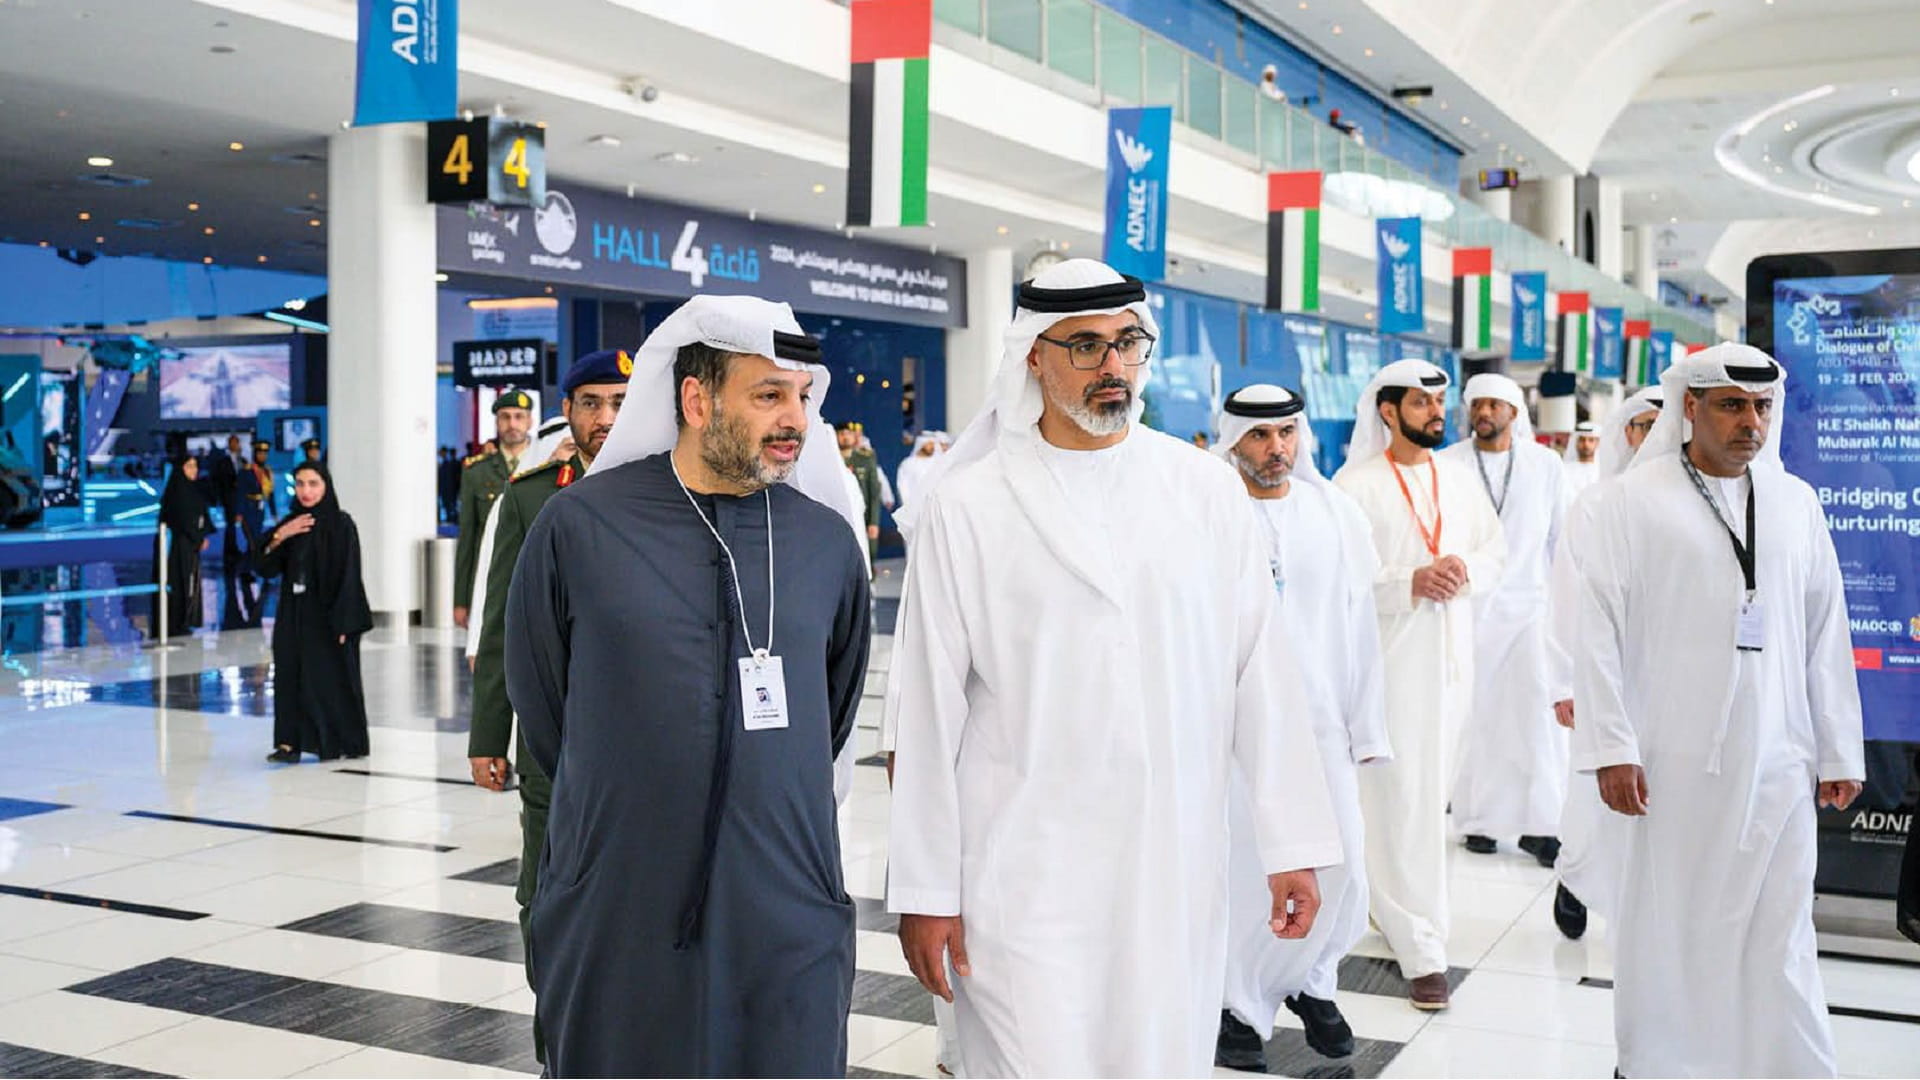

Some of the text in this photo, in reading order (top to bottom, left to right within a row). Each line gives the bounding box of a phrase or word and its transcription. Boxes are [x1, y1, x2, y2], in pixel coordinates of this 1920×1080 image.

[392, 0, 419, 65] AD
[443, 134, 473, 185] 4
[503, 138, 530, 188] 4
[1127, 178, 1147, 251] ADNEC
[592, 220, 710, 288] HALL 4
[708, 243, 760, 283] قاعة
[1816, 340, 1874, 355] Dialogue
[1876, 340, 1890, 353] of
[1818, 373, 1832, 385] 19
[1843, 418, 1891, 431] Sheikh
[1817, 436, 1879, 449] Mubarak
[1882, 436, 1897, 449] Al
[1818, 487, 1908, 510] Bridging
[1850, 619, 1888, 632] NAOC
[1850, 811, 1913, 833] ADNE
